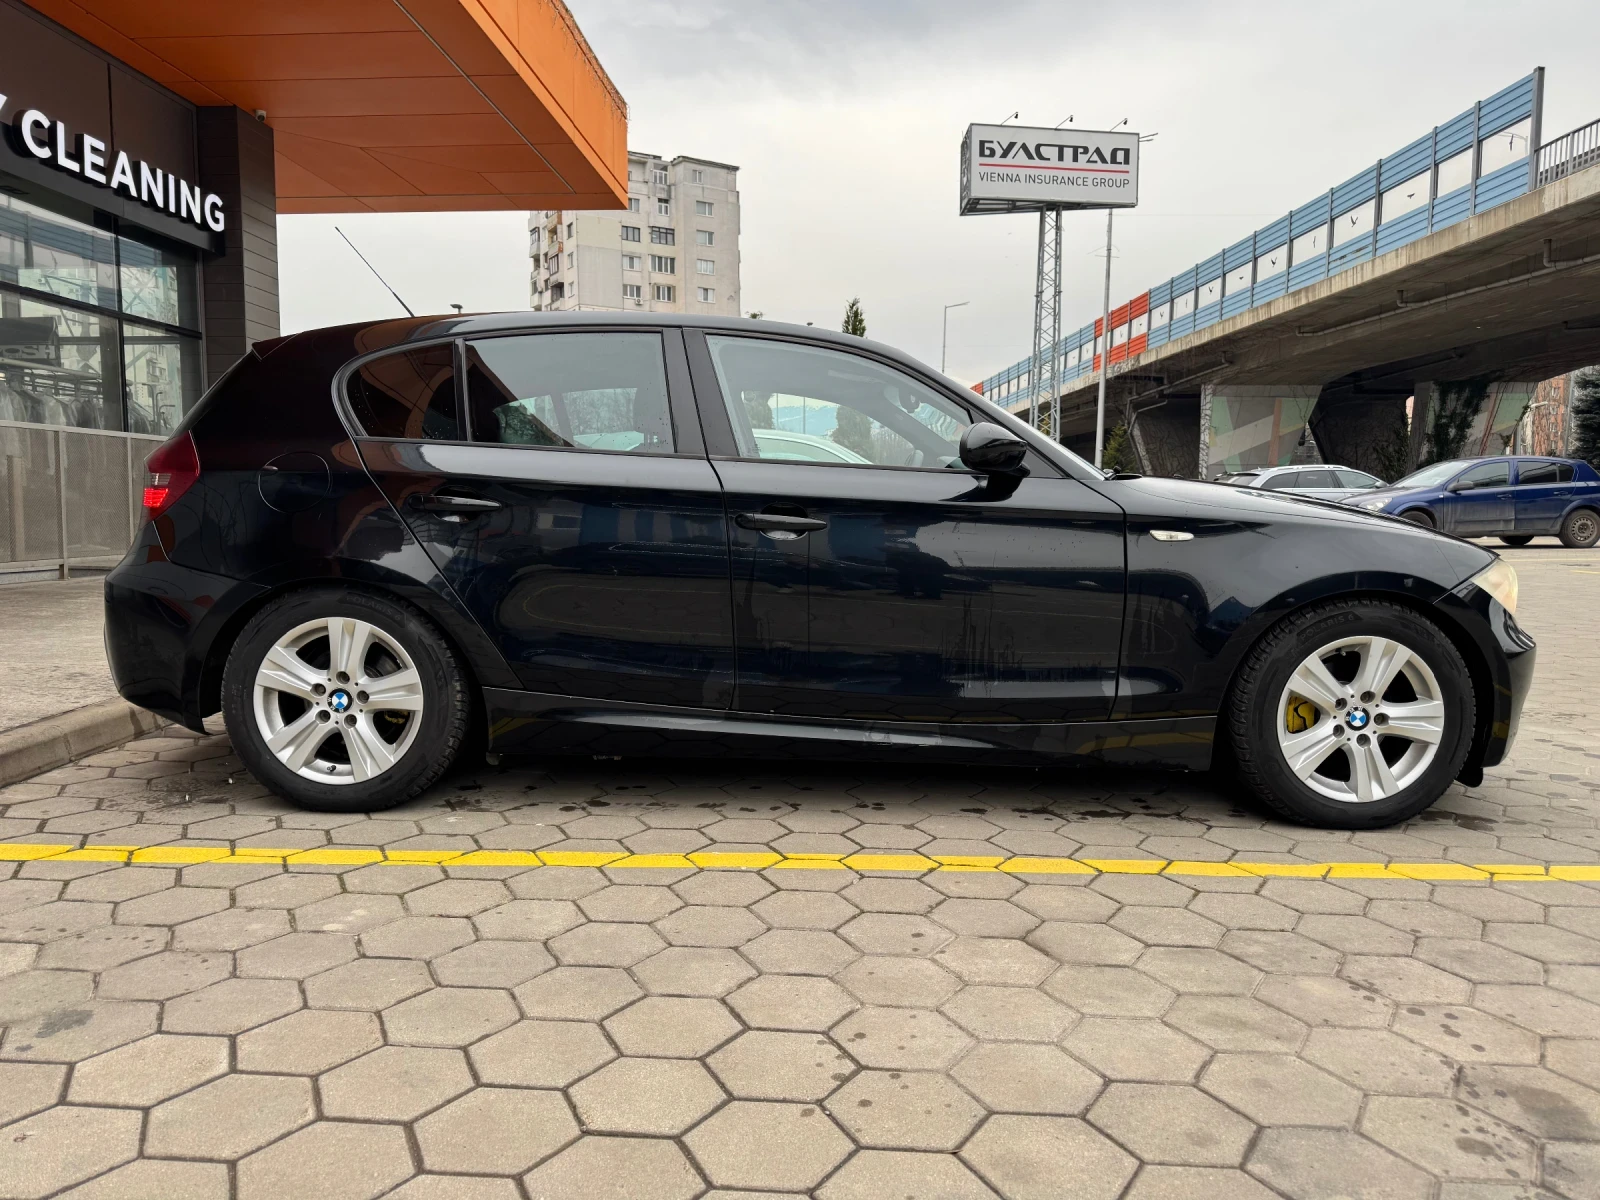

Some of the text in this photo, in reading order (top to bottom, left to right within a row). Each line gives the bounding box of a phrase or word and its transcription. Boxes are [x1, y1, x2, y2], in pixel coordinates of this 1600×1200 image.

[978, 139, 1131, 166] БУЛСТРАД
[21, 109, 225, 232] CLEANING
[978, 171, 1130, 189] VIENNA INSURANCE GROUP
[346, 595, 393, 615] POLARIS
[1300, 613, 1355, 641] POLARIS 6
